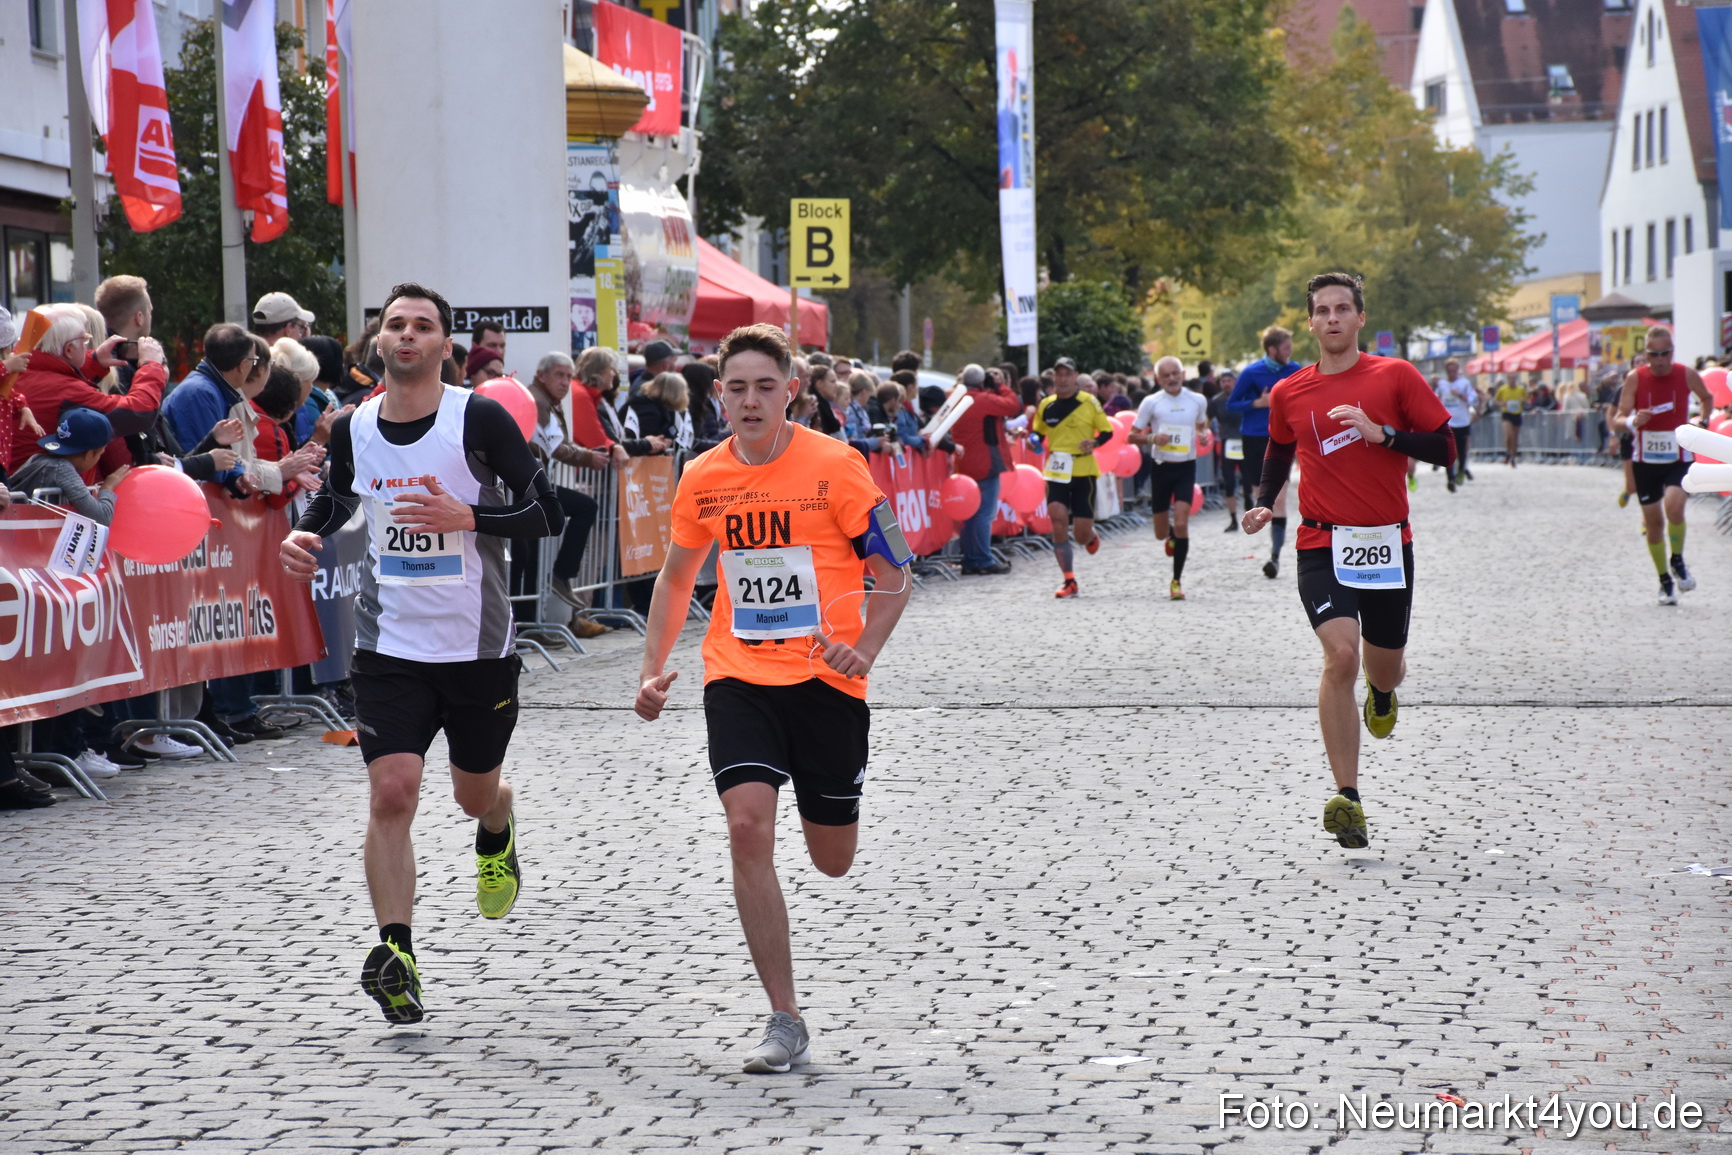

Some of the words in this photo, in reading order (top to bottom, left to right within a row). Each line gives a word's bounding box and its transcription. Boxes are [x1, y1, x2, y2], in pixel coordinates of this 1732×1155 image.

[798, 203, 842, 218] Block
[806, 226, 835, 268] B
[1186, 323, 1203, 347] C
[1333, 433, 1351, 446] DEHN
[1647, 441, 1672, 451] 2151
[386, 475, 442, 489] KLEL
[696, 496, 718, 506] URBAN
[719, 494, 739, 504] SPORT
[739, 491, 759, 500] VIBES
[799, 502, 829, 512] SPEED
[725, 510, 790, 549] RUN
[220, 545, 233, 568] die
[753, 557, 785, 566] BOCK
[1342, 545, 1392, 567] 2269
[401, 559, 436, 571] Thomas
[1356, 571, 1381, 581] Jürgen
[738, 574, 803, 604] 2124
[756, 612, 789, 624] Manuel
